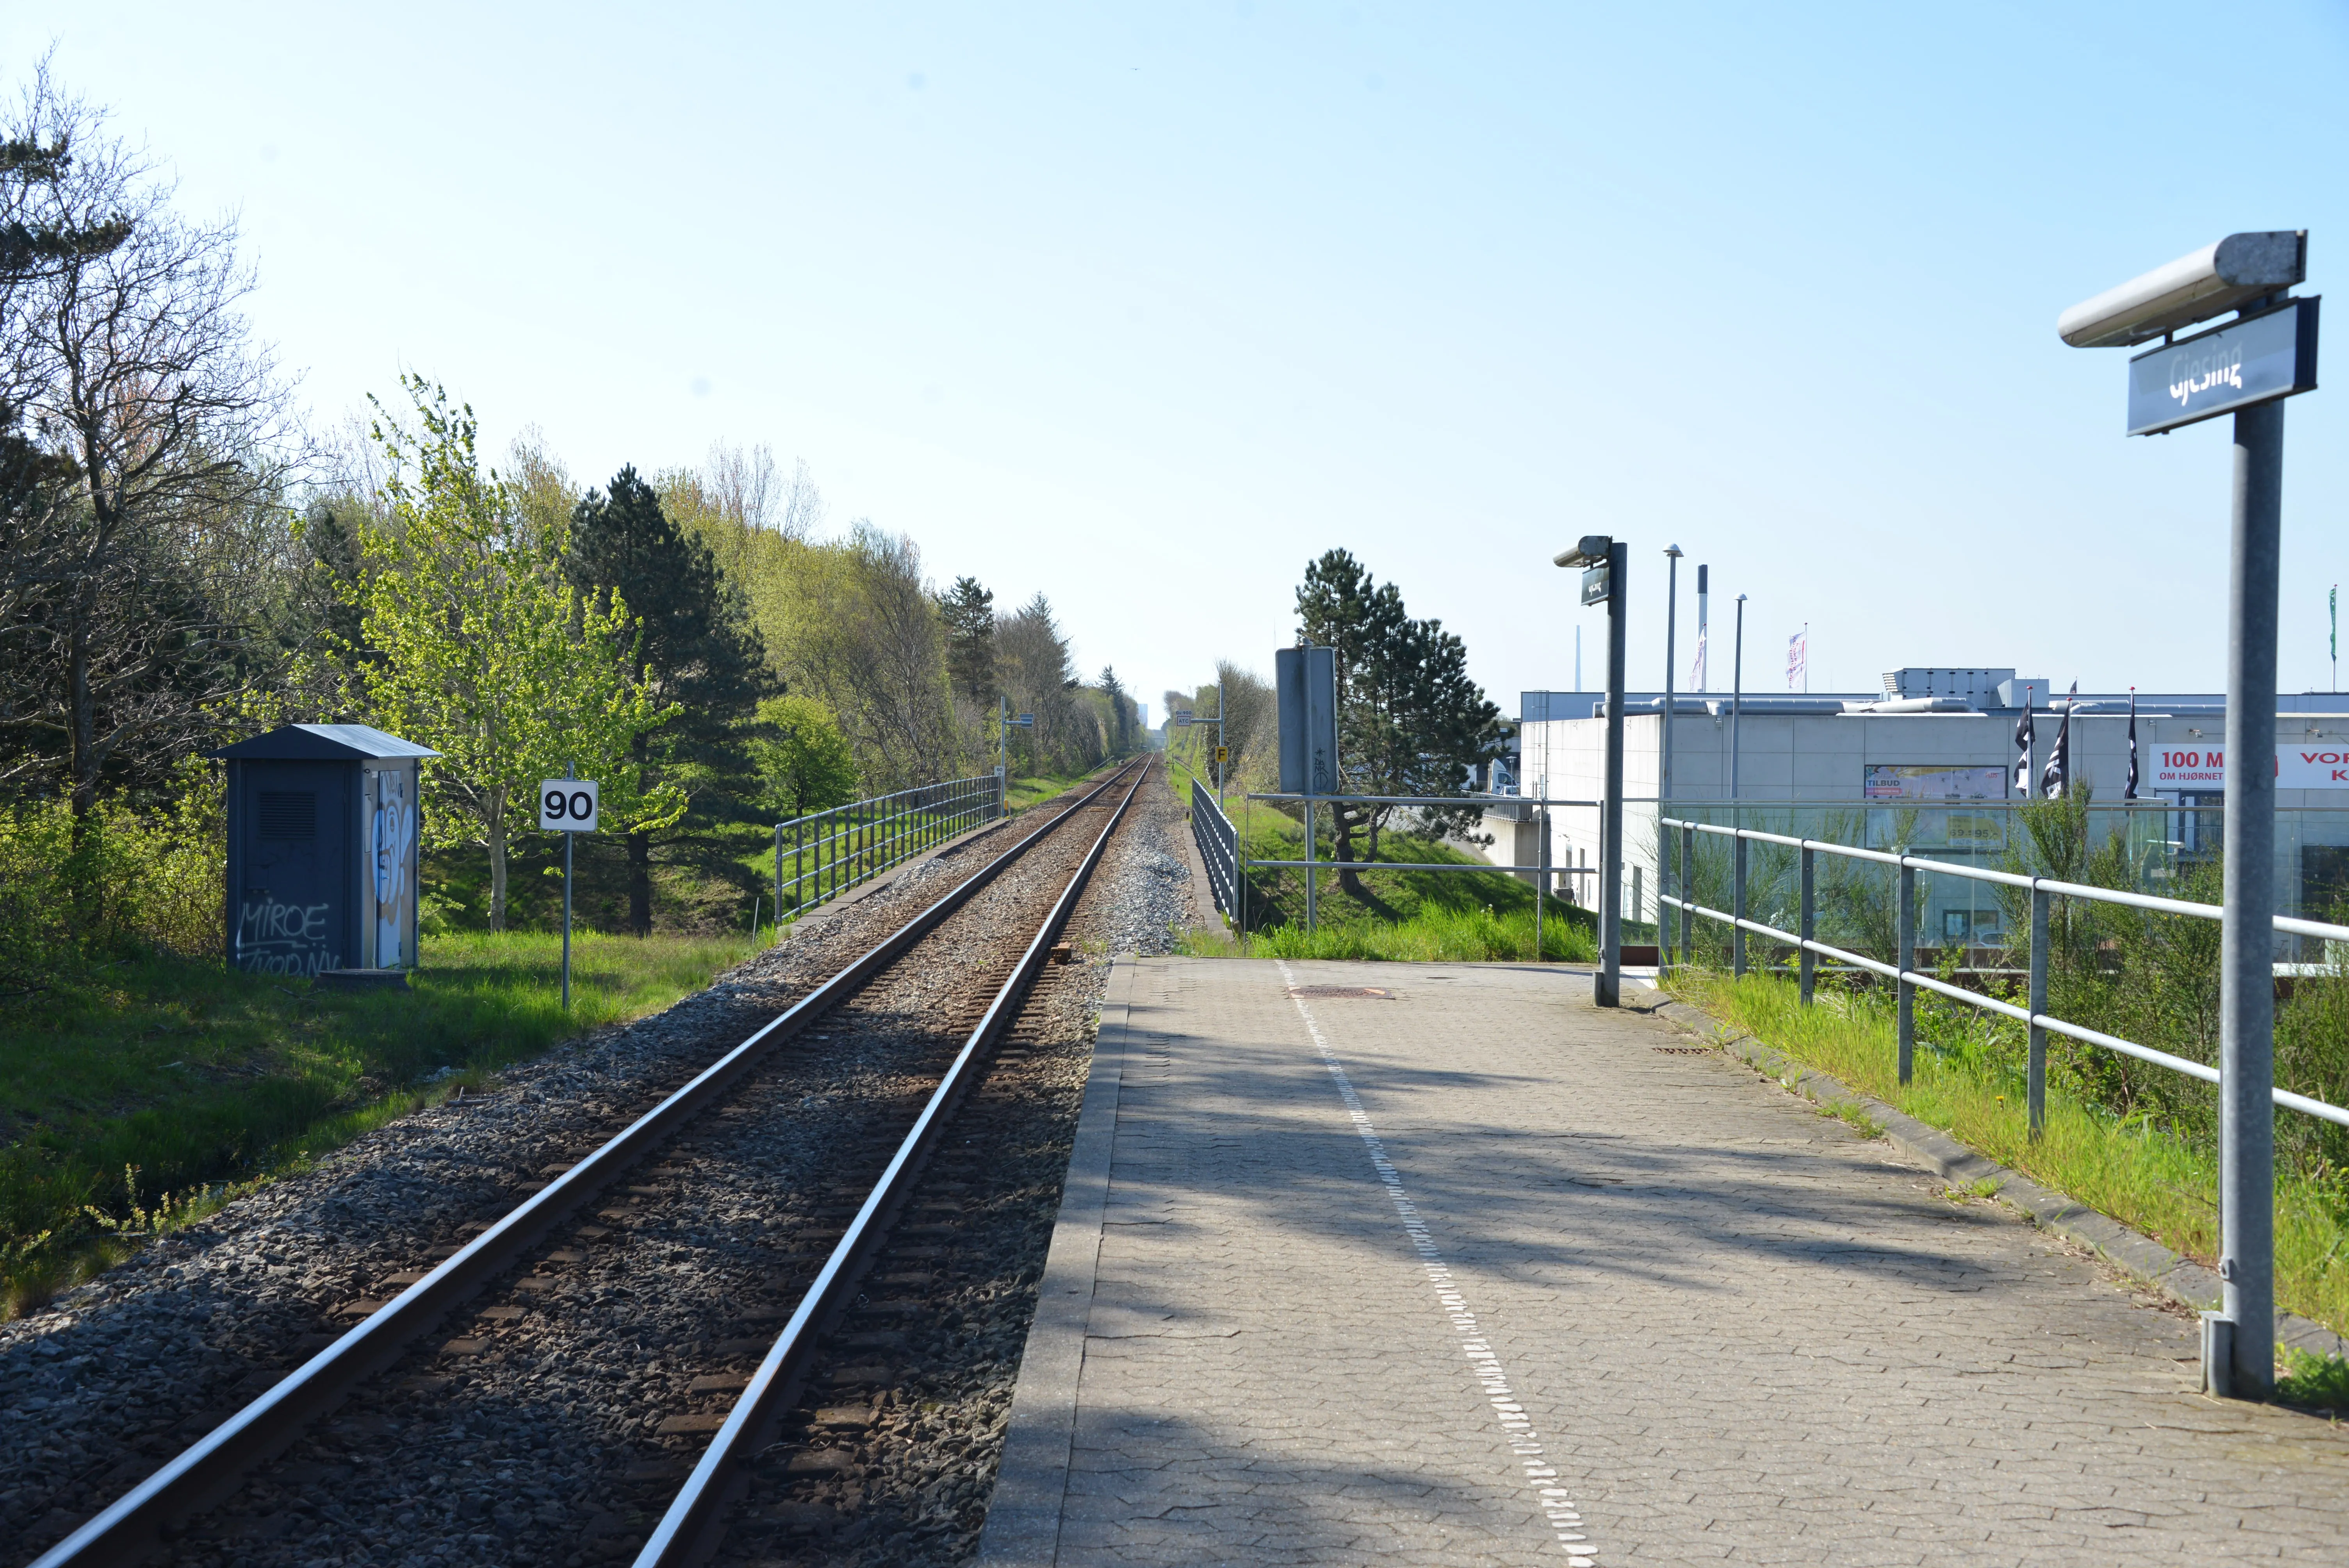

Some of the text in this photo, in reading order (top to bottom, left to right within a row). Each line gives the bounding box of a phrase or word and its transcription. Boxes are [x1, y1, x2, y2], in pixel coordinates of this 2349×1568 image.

[1218, 749, 1225, 760] F
[2162, 752, 2223, 768] 100 M
[2179, 772, 2223, 780] HJØRNET
[545, 790, 592, 821] 90
